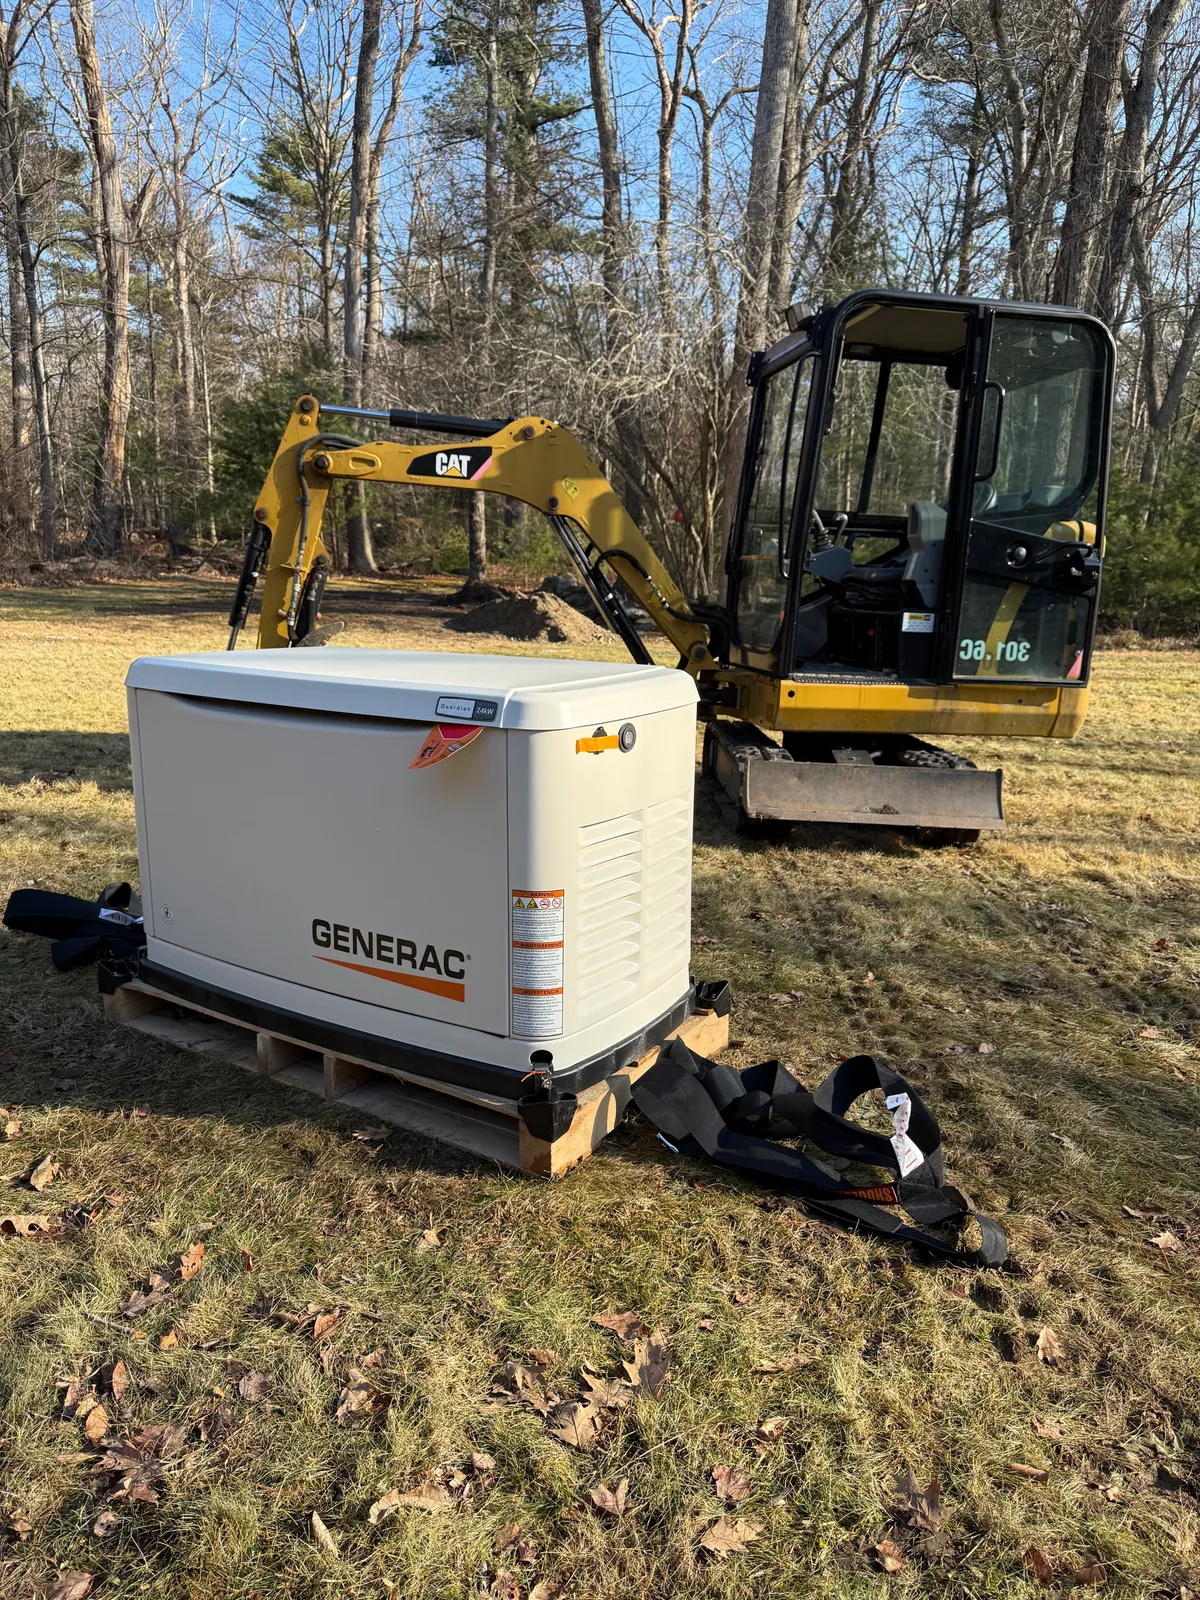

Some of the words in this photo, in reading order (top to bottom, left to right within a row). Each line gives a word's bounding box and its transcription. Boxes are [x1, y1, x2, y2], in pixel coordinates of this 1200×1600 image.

[435, 452, 471, 478] CAT
[440, 703, 471, 711] Guardian
[476, 706, 495, 715] 24kW
[312, 918, 465, 980] GENERAC
